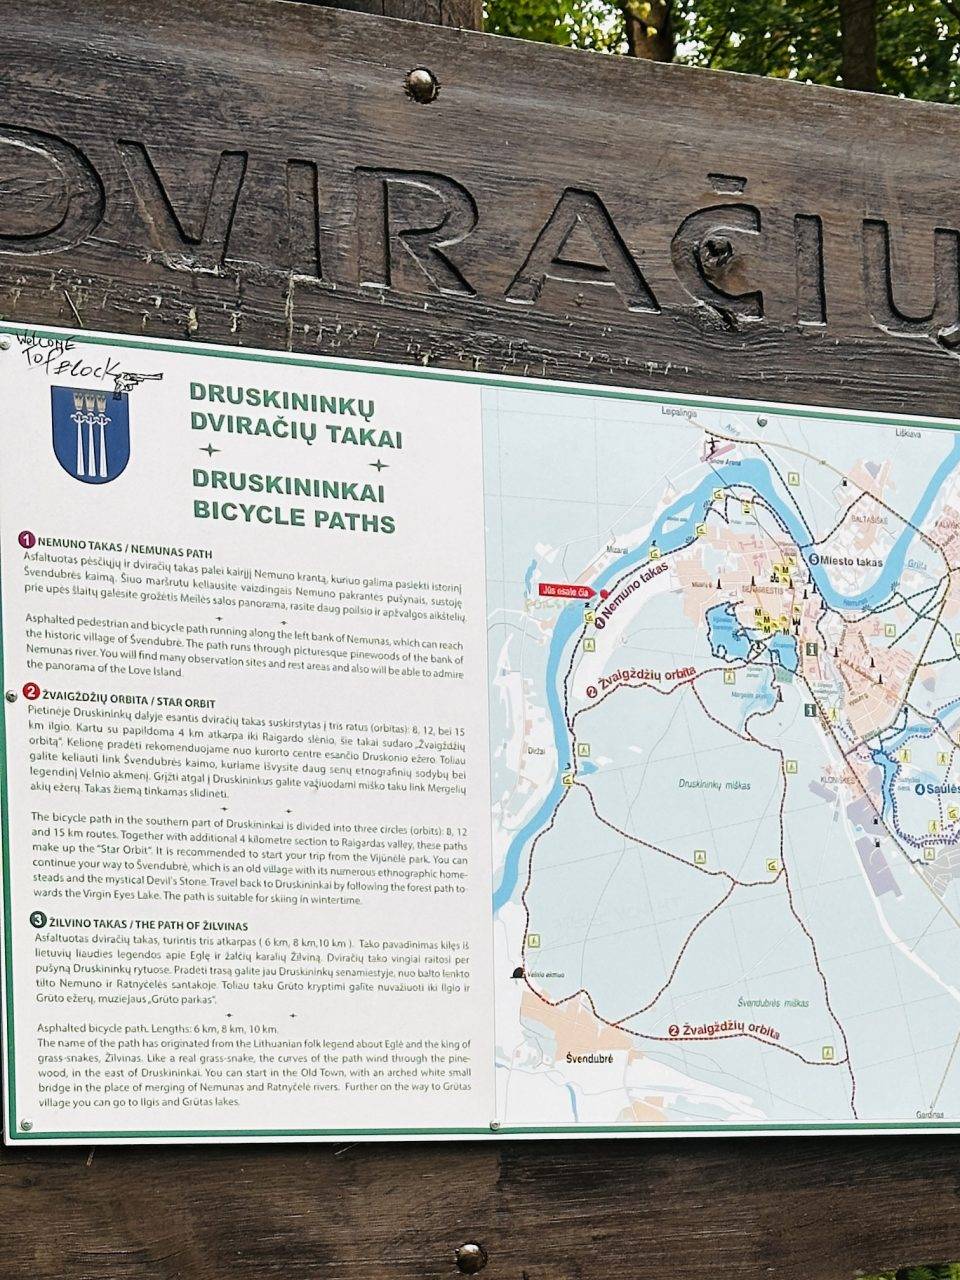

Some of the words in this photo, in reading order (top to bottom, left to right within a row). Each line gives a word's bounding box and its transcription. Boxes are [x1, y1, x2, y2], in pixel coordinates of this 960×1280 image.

[189, 381, 376, 423] DRUSKININKŲ
[190, 411, 317, 446] DVIRAČIŲ
[326, 424, 403, 450] TAKAI
[192, 468, 386, 503] DRUSKININKAI
[193, 499, 305, 528] BICYCLE
[314, 509, 397, 535] PATHS
[37, 537, 88, 550] NEMUNO
[88, 541, 122, 552] TAKAS
[131, 544, 184, 556] NEMUNAS
[186, 548, 212, 558] PATH
[820, 555, 854, 566] Miesto
[856, 556, 883, 568] takas
[543, 586, 556, 596] Jūs
[602, 580, 640, 620] Nemuno
[640, 562, 669, 585] takas
[25, 612, 75, 625] Asphalted
[76, 616, 129, 628] pedestrian
[130, 620, 149, 630] and
[151, 620, 184, 633] bicycle
[186, 624, 208, 635] path
[209, 627, 247, 638] running
[248, 627, 275, 640] along
[277, 629, 292, 639] the
[294, 630, 309, 640] left
[311, 631, 334, 642] bank
[335, 633, 345, 642] of
[346, 634, 391, 646] Nemunas,
[393, 637, 420, 647] which
[439, 641, 463, 650] reach
[26, 658, 43, 669] the
[45, 662, 95, 672] panorama
[97, 662, 108, 672] of
[109, 664, 126, 673] the
[128, 665, 151, 675] Love
[598, 668, 661, 690] Žvaigždžių
[665, 667, 696, 680] orbita
[42, 690, 108, 704] ŽVAIGŽDŽIŲ
[109, 694, 148, 705] ORBITA
[156, 696, 182, 707] STAR
[184, 698, 215, 708] ORBIT
[679, 779, 721, 791] Druskininkų
[726, 781, 751, 790] miškas
[33, 887, 63, 897] wards
[64, 888, 81, 897] the
[82, 888, 111, 900] Virgin
[113, 889, 135, 901] Eyes
[137, 890, 161, 899] Lake.
[162, 890, 181, 900] The
[183, 891, 205, 902] path
[207, 892, 214, 901] is
[216, 892, 253, 902] suitable
[255, 892, 268, 902] for
[270, 893, 298, 905] skiing
[299, 894, 309, 903] in
[49, 916, 92, 928] ŽILVINO
[93, 919, 127, 928] TAKAS
[135, 920, 155, 929] THE
[157, 920, 184, 929] PATH
[186, 921, 200, 930] OF
[202, 920, 248, 931] ŽILVINAS
[784, 999, 809, 1008] miškas
[36, 1022, 86, 1034] Asphalted
[88, 1023, 122, 1035] bicycle
[124, 1024, 149, 1034] path.
[151, 1023, 191, 1035] Lengths:
[193, 1024, 200, 1033] 6
[201, 1024, 219, 1034] km,
[221, 1024, 227, 1033] 8
[229, 1024, 246, 1034] km,
[249, 1024, 260, 1033] 10
[683, 1020, 745, 1036] Žvaigždžių
[748, 1023, 780, 1040] orbita
[566, 1052, 614, 1064] Švendubrė
[38, 1097, 70, 1109] village
[72, 1099, 91, 1109] you
[112, 1099, 126, 1108] go
[128, 1098, 138, 1106] to
[161, 1096, 180, 1106] and
